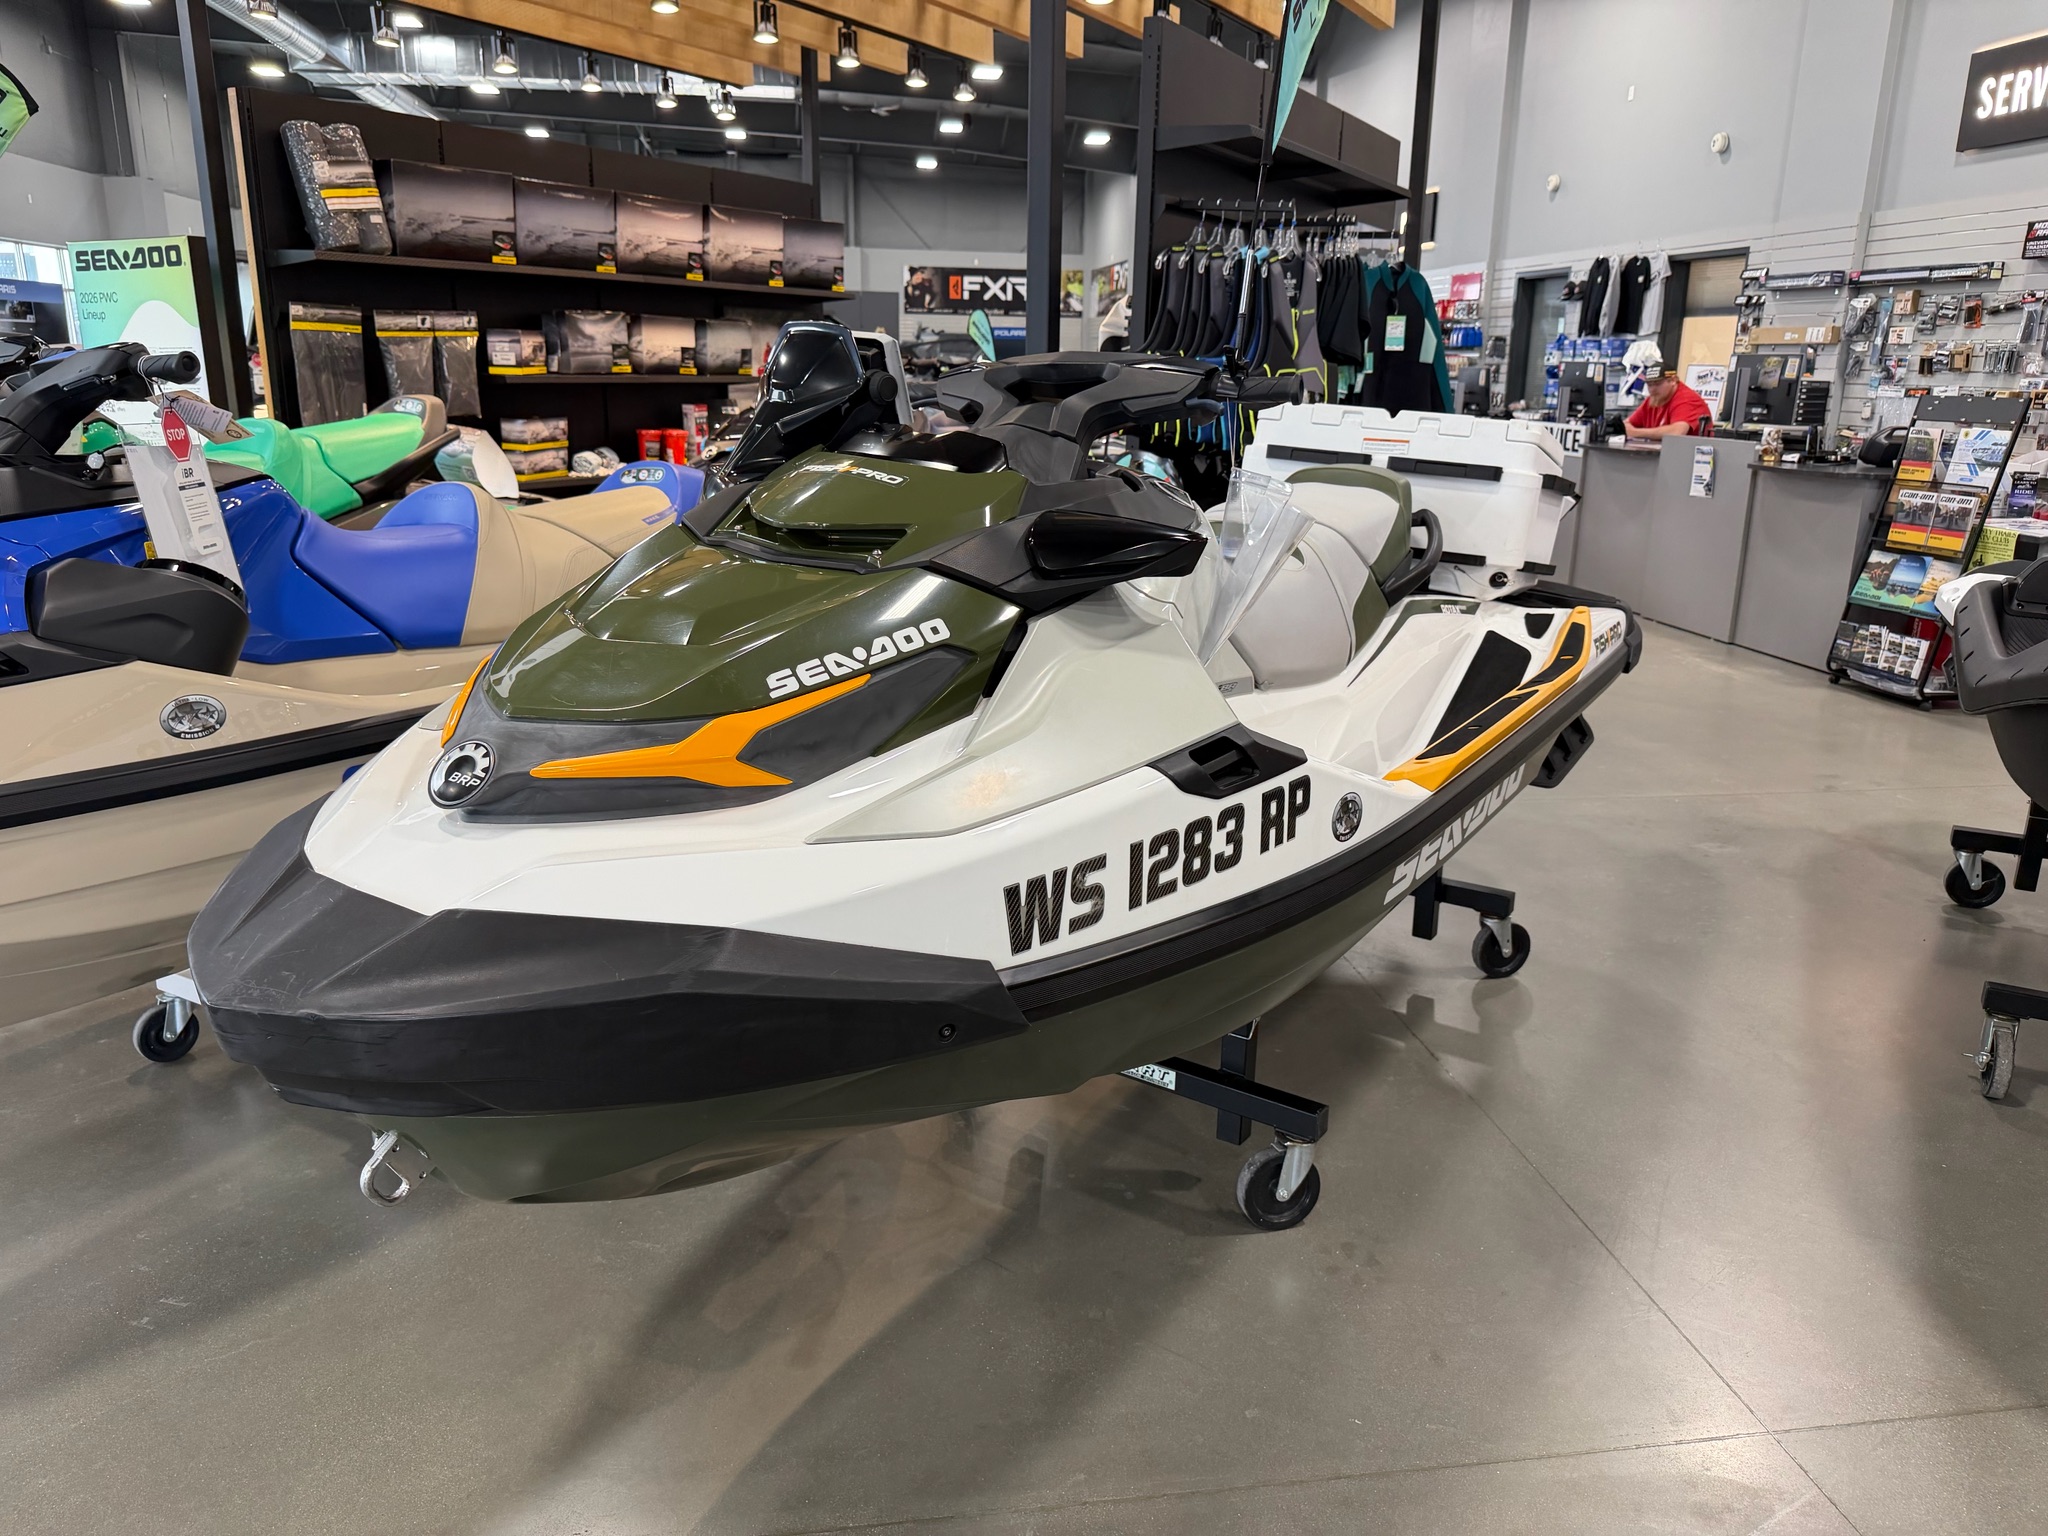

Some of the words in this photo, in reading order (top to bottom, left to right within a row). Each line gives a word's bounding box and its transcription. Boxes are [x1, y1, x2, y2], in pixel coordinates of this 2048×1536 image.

[962, 275, 1027, 301] FXR
[80, 292, 98, 304] 2026
[99, 291, 119, 304] PWC
[82, 308, 106, 321] Lineup
[166, 428, 186, 441] STOP
[181, 467, 194, 478] iBR
[1995, 529, 2017, 538] TRAILS
[180, 728, 215, 739] EMISSION
[448, 771, 481, 787] BRP
[1003, 853, 1107, 957] WS
[1128, 802, 1246, 912] 1283
[1260, 774, 1312, 856] RP
